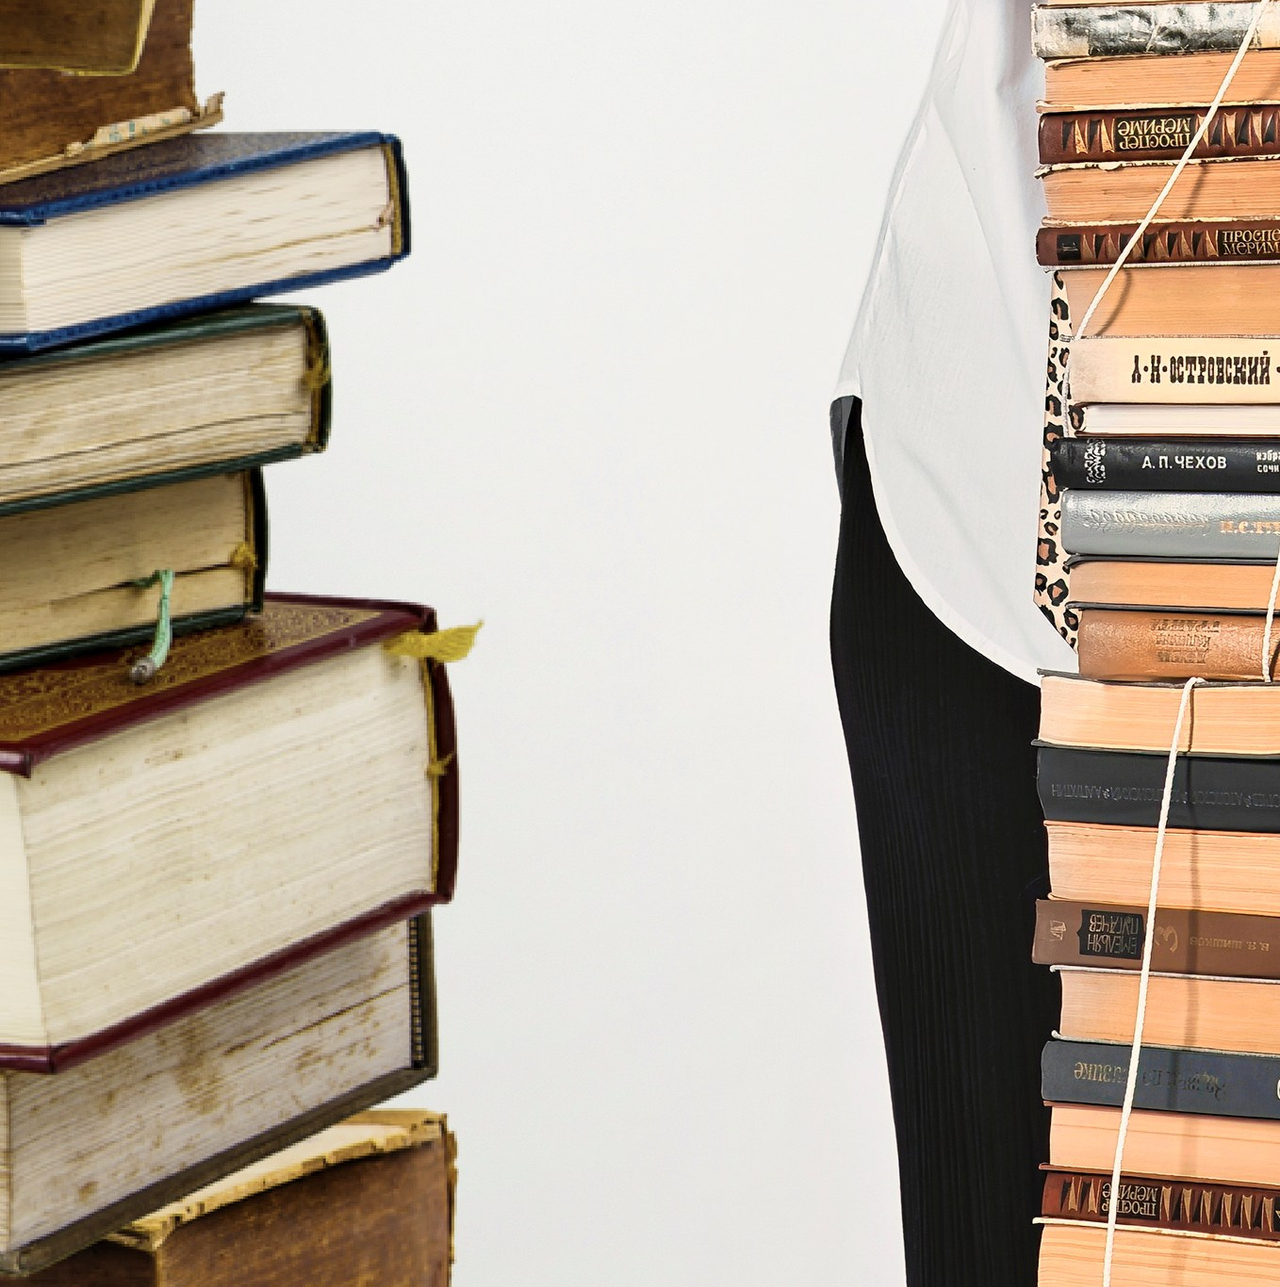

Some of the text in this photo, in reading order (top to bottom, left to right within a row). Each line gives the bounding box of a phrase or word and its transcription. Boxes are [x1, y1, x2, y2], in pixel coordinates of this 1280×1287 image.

[1119, 132, 1191, 150] ПРОСПЕР
[1174, 455, 1228, 470] ЧЕХОВ
[1088, 914, 1139, 935] ПУГАЧЕВ
[1087, 932, 1138, 954] ЕМЕЛЬЯН
[1102, 1183, 1158, 1203] МЕРИЕ
[1101, 1200, 1156, 1217] ПРОСПР
